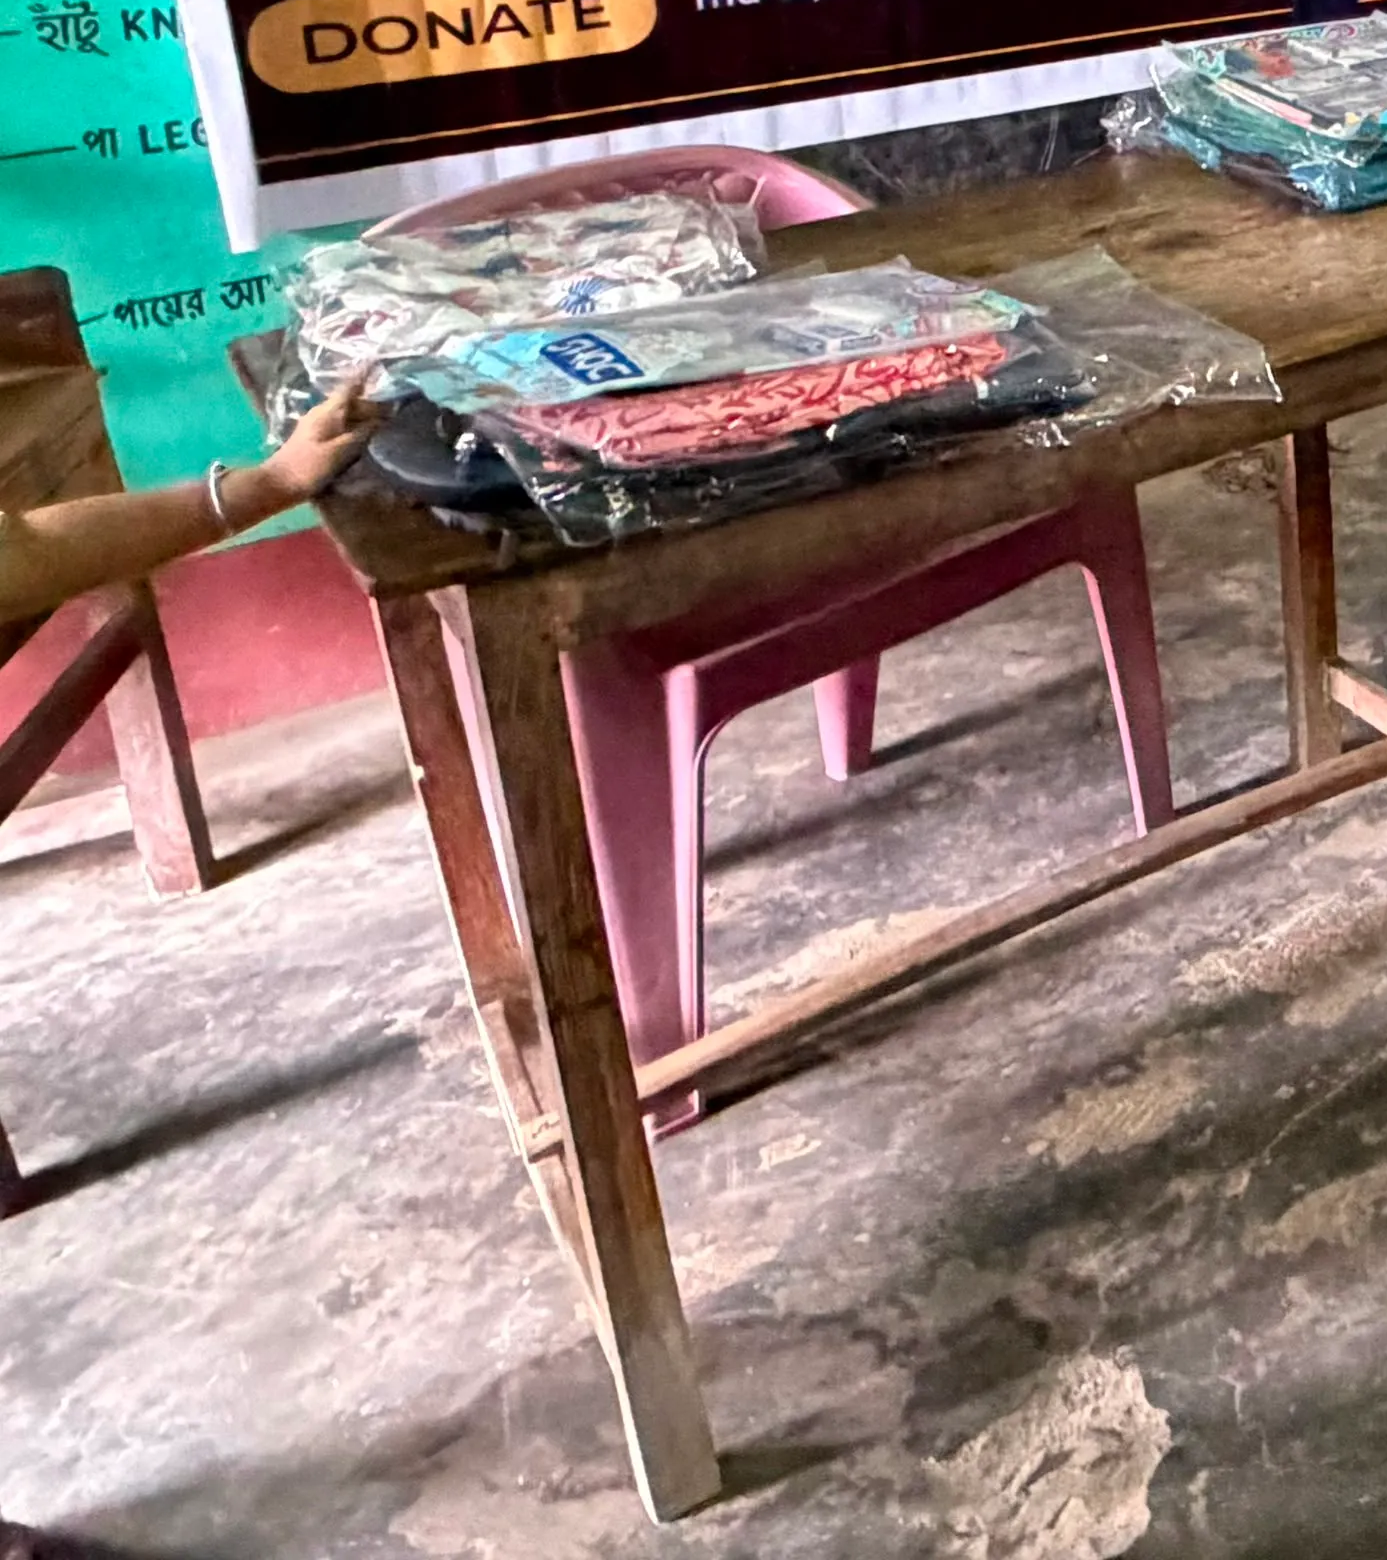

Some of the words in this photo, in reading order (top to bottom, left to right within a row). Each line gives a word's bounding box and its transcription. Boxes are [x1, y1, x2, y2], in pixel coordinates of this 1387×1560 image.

[120, 6, 180, 41] KN
[82, 127, 120, 159] পা
[113, 287, 205, 331] পায়ের
